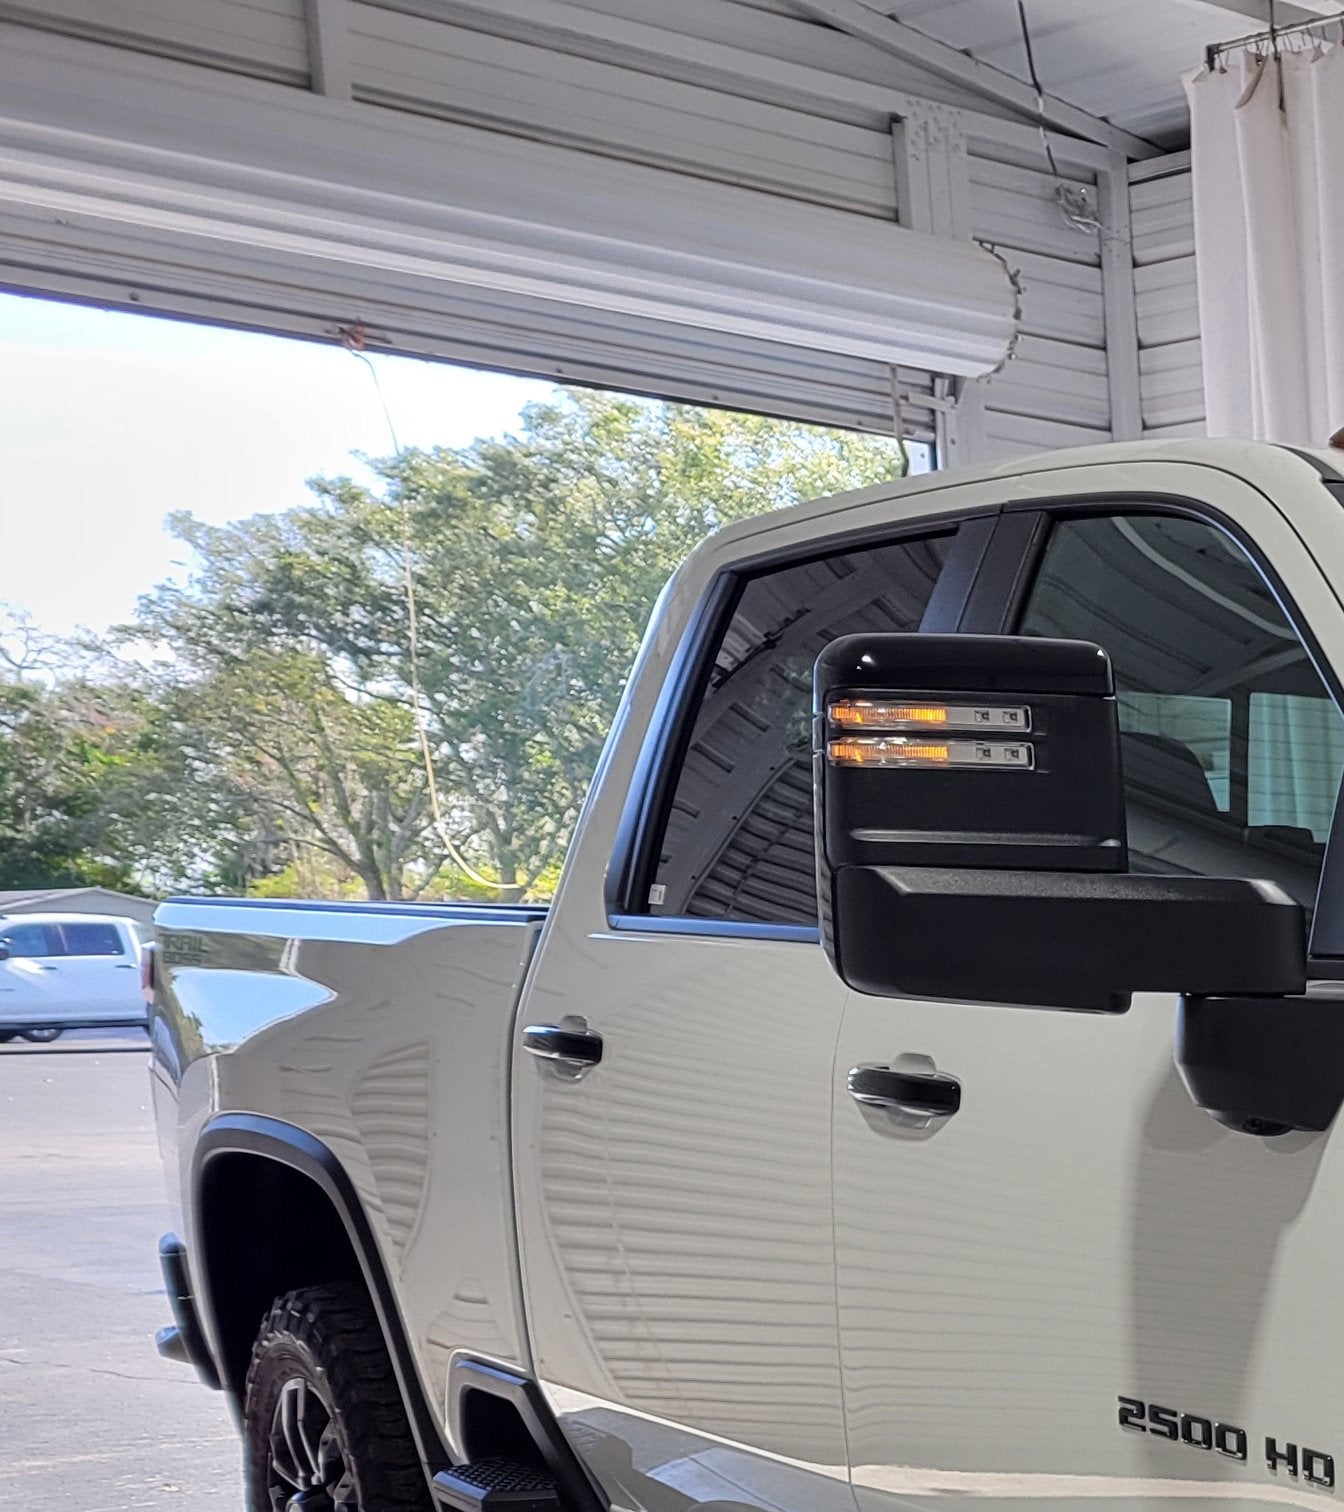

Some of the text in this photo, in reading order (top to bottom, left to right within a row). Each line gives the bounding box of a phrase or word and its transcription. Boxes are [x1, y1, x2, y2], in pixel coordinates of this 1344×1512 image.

[158, 933, 209, 953] TRAIL
[162, 950, 202, 966] BOSS
[1117, 1395, 1335, 1488] 2500 HD
